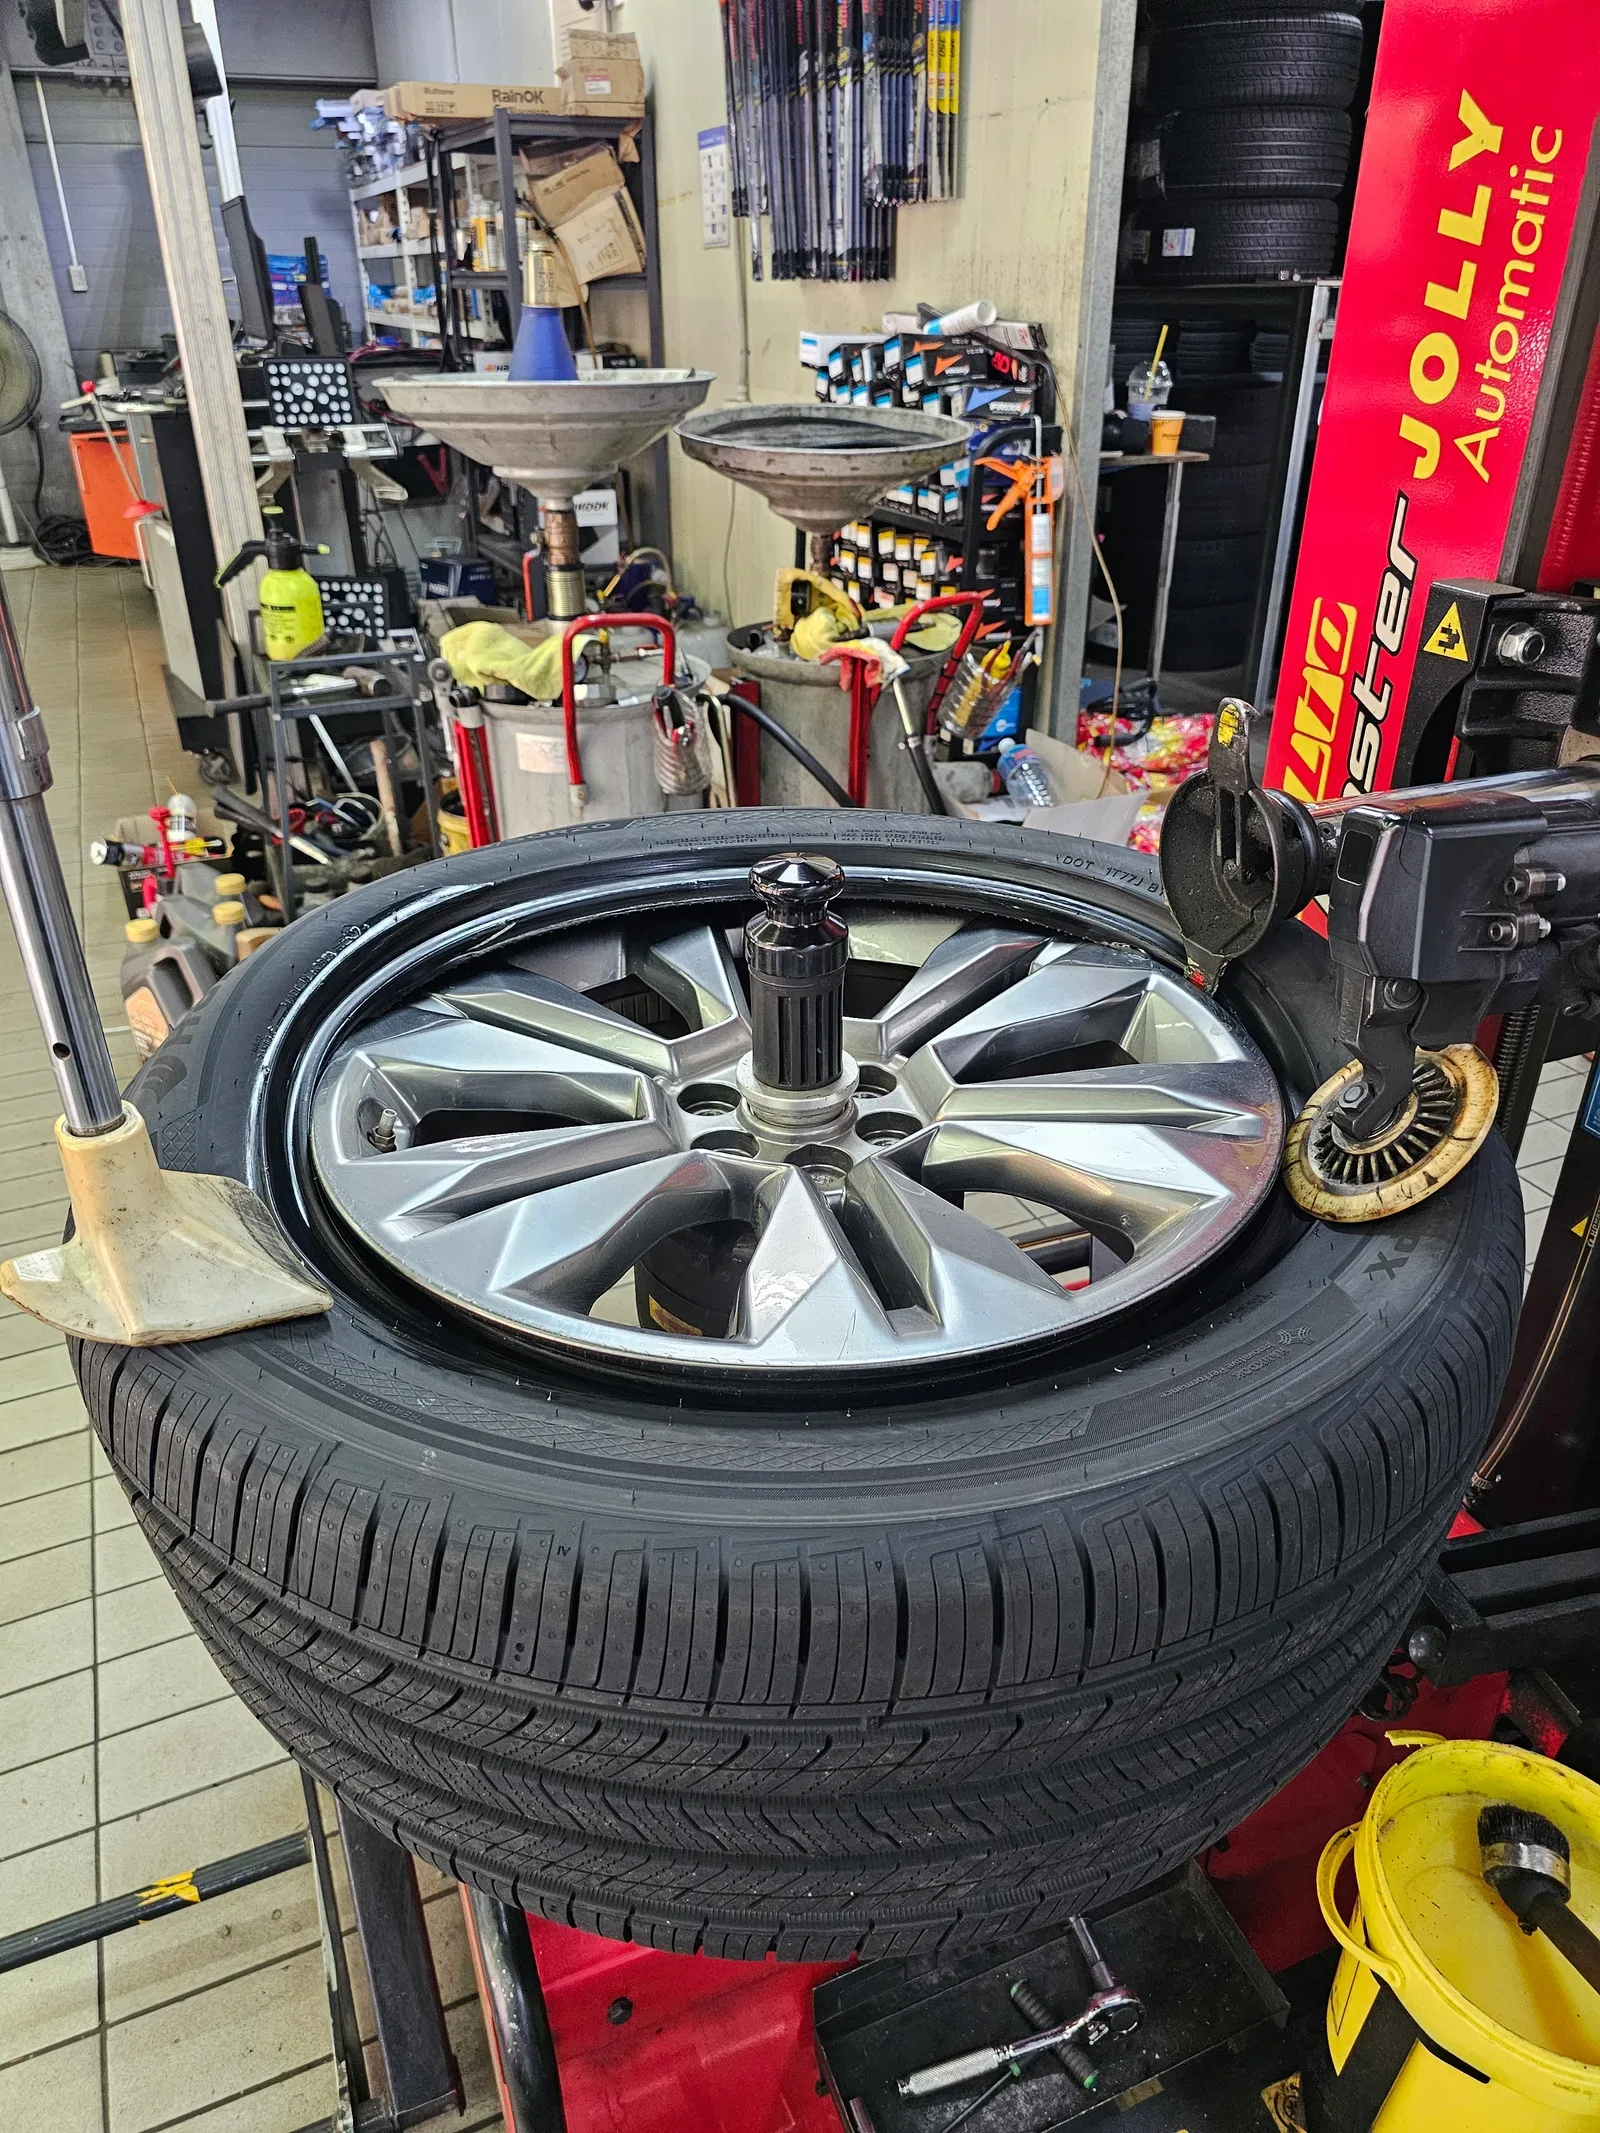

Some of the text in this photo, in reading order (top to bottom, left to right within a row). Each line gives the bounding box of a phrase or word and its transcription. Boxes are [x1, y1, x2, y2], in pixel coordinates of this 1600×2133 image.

[491, 89, 545, 104] RainOK
[1399, 88, 1504, 480] JOLLY
[1453, 125, 1563, 483] Automatic
[1062, 855, 1095, 870] DOT
[1159, 1366, 1226, 1399] Performance
[352, 1391, 426, 1424] TREADWEAR
